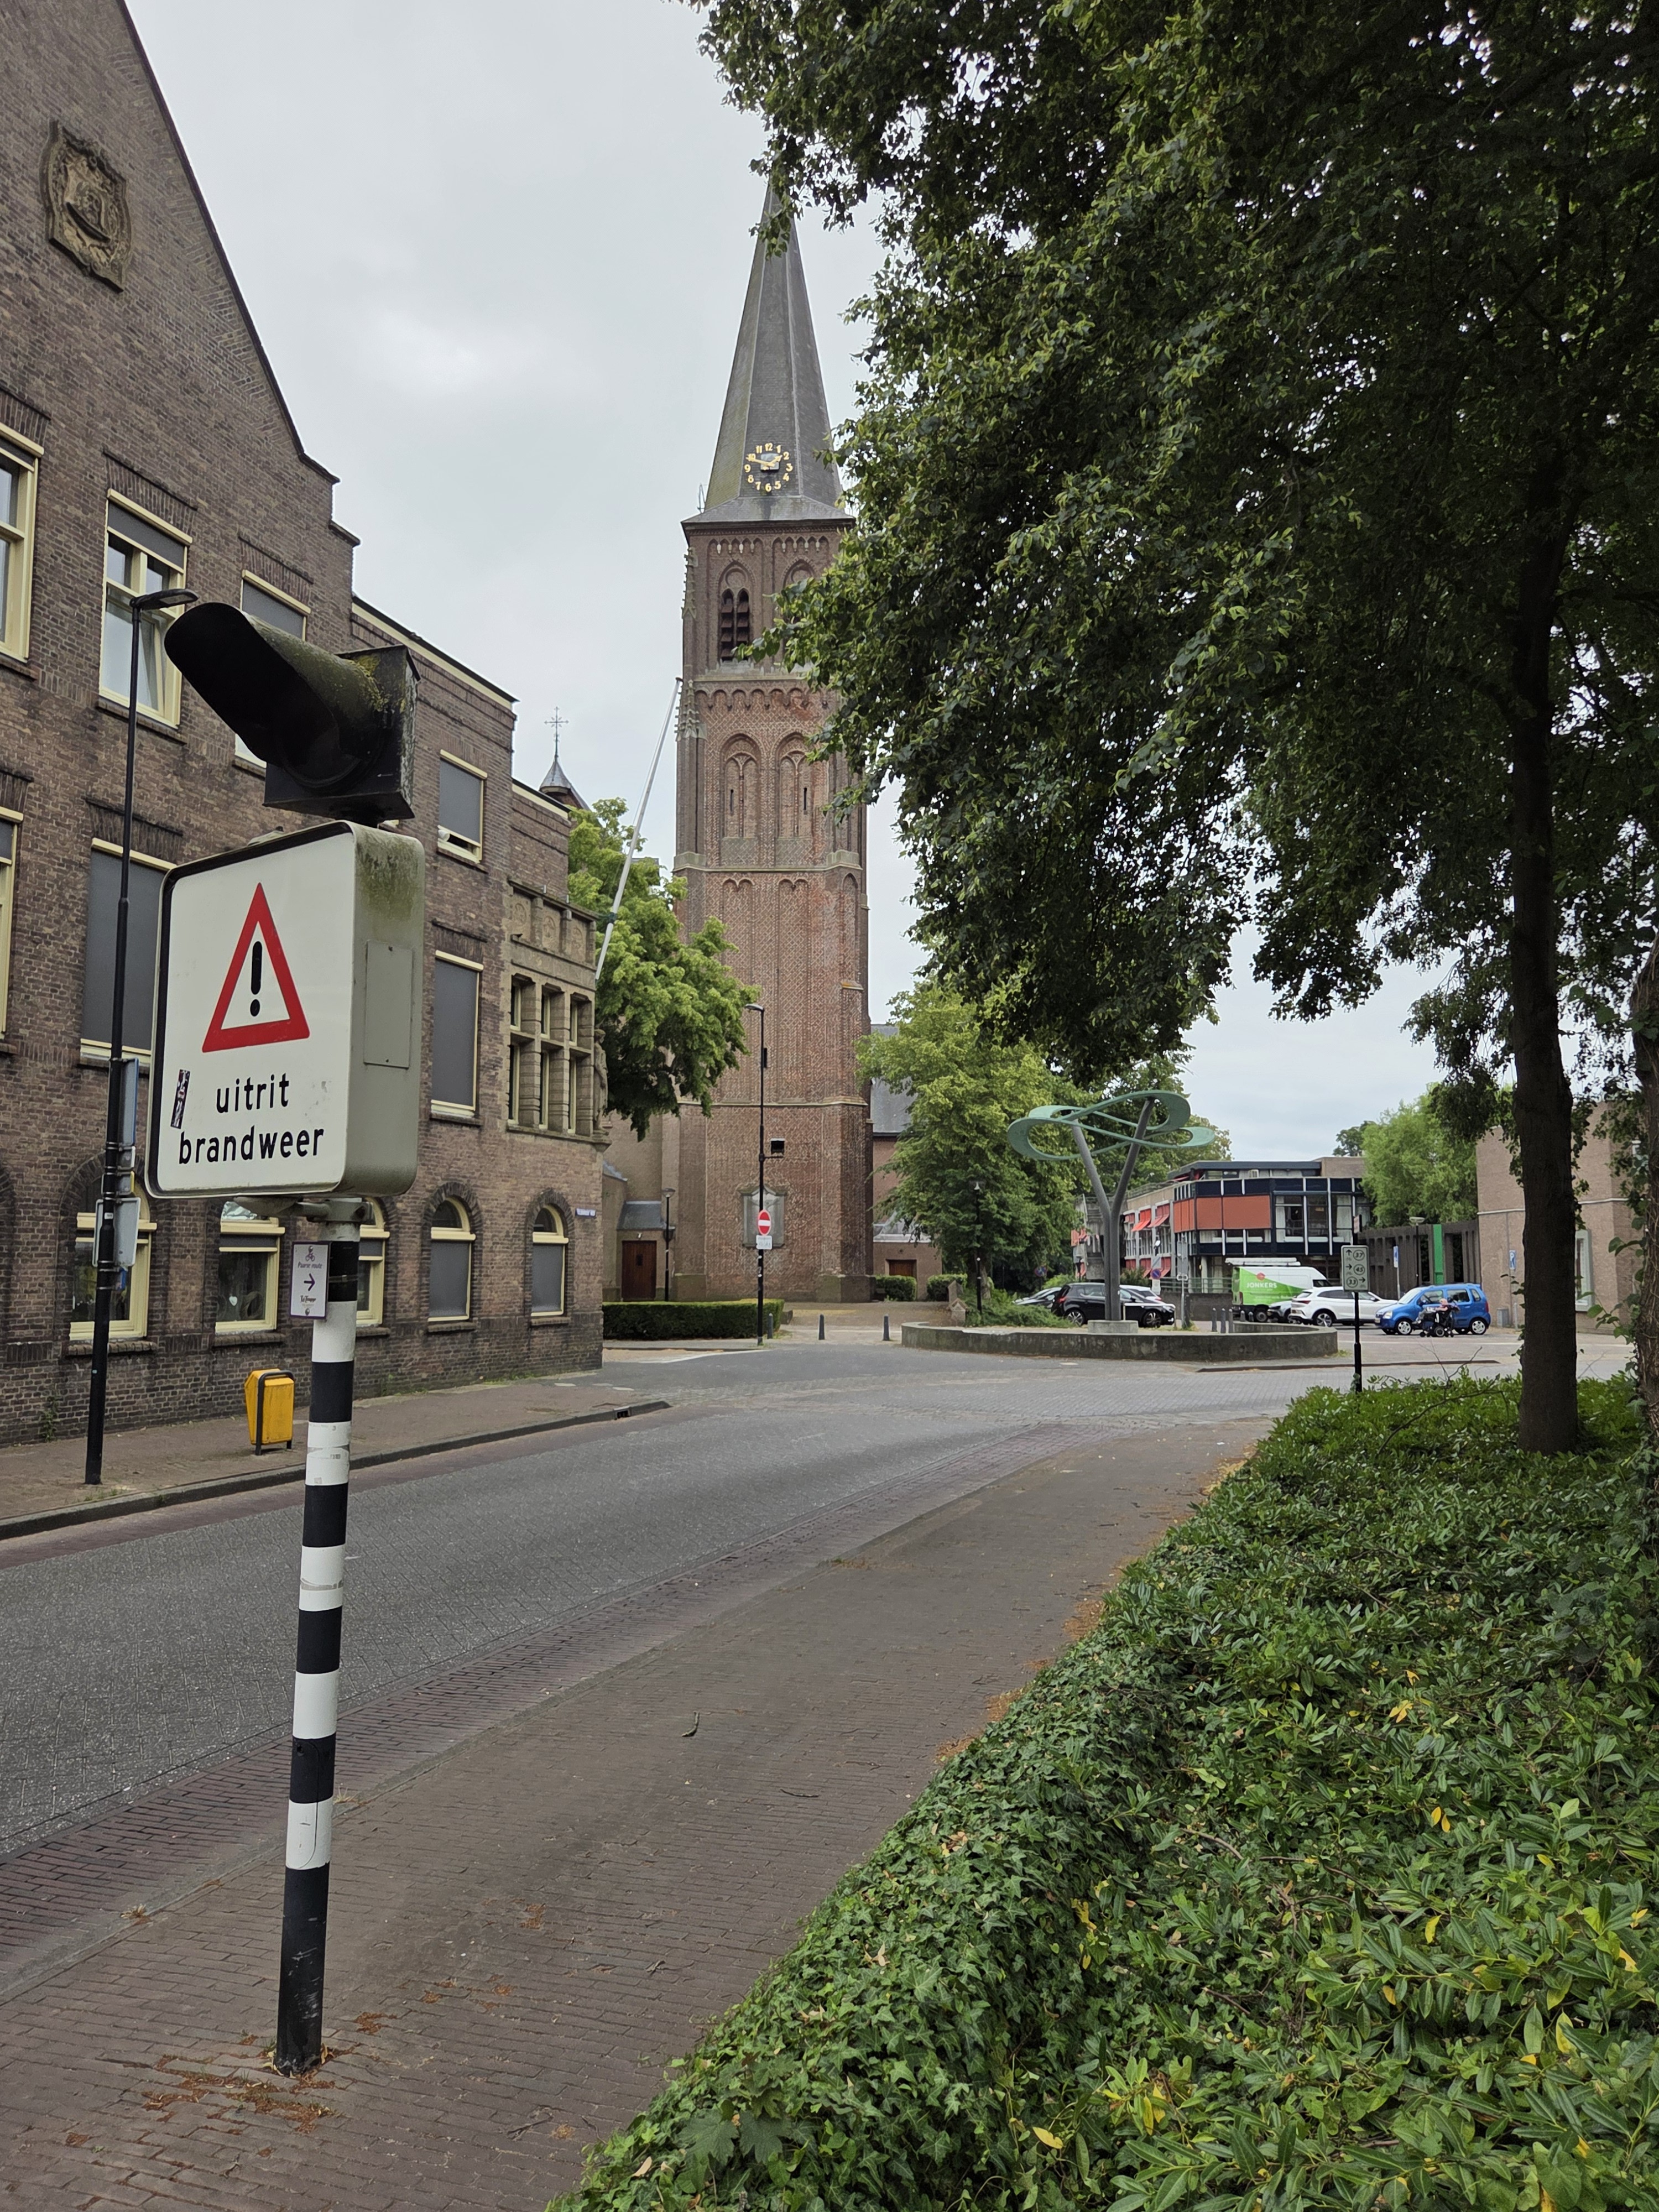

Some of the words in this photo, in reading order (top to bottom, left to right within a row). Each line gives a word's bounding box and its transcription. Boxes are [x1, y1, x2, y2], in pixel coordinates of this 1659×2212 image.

[755, 445, 763, 453] 11
[765, 442, 773, 451] 12
[776, 445, 781, 453] 1
[783, 451, 790, 460] 2
[744, 464, 751, 473] 9
[786, 463, 793, 472] 3
[748, 474, 754, 483] 8
[782, 473, 790, 482] 4
[755, 481, 761, 491] 7
[765, 483, 772, 492] 6
[774, 481, 781, 489] 5
[216, 1073, 289, 1113] uitrit
[179, 1125, 324, 1164] brandweer
